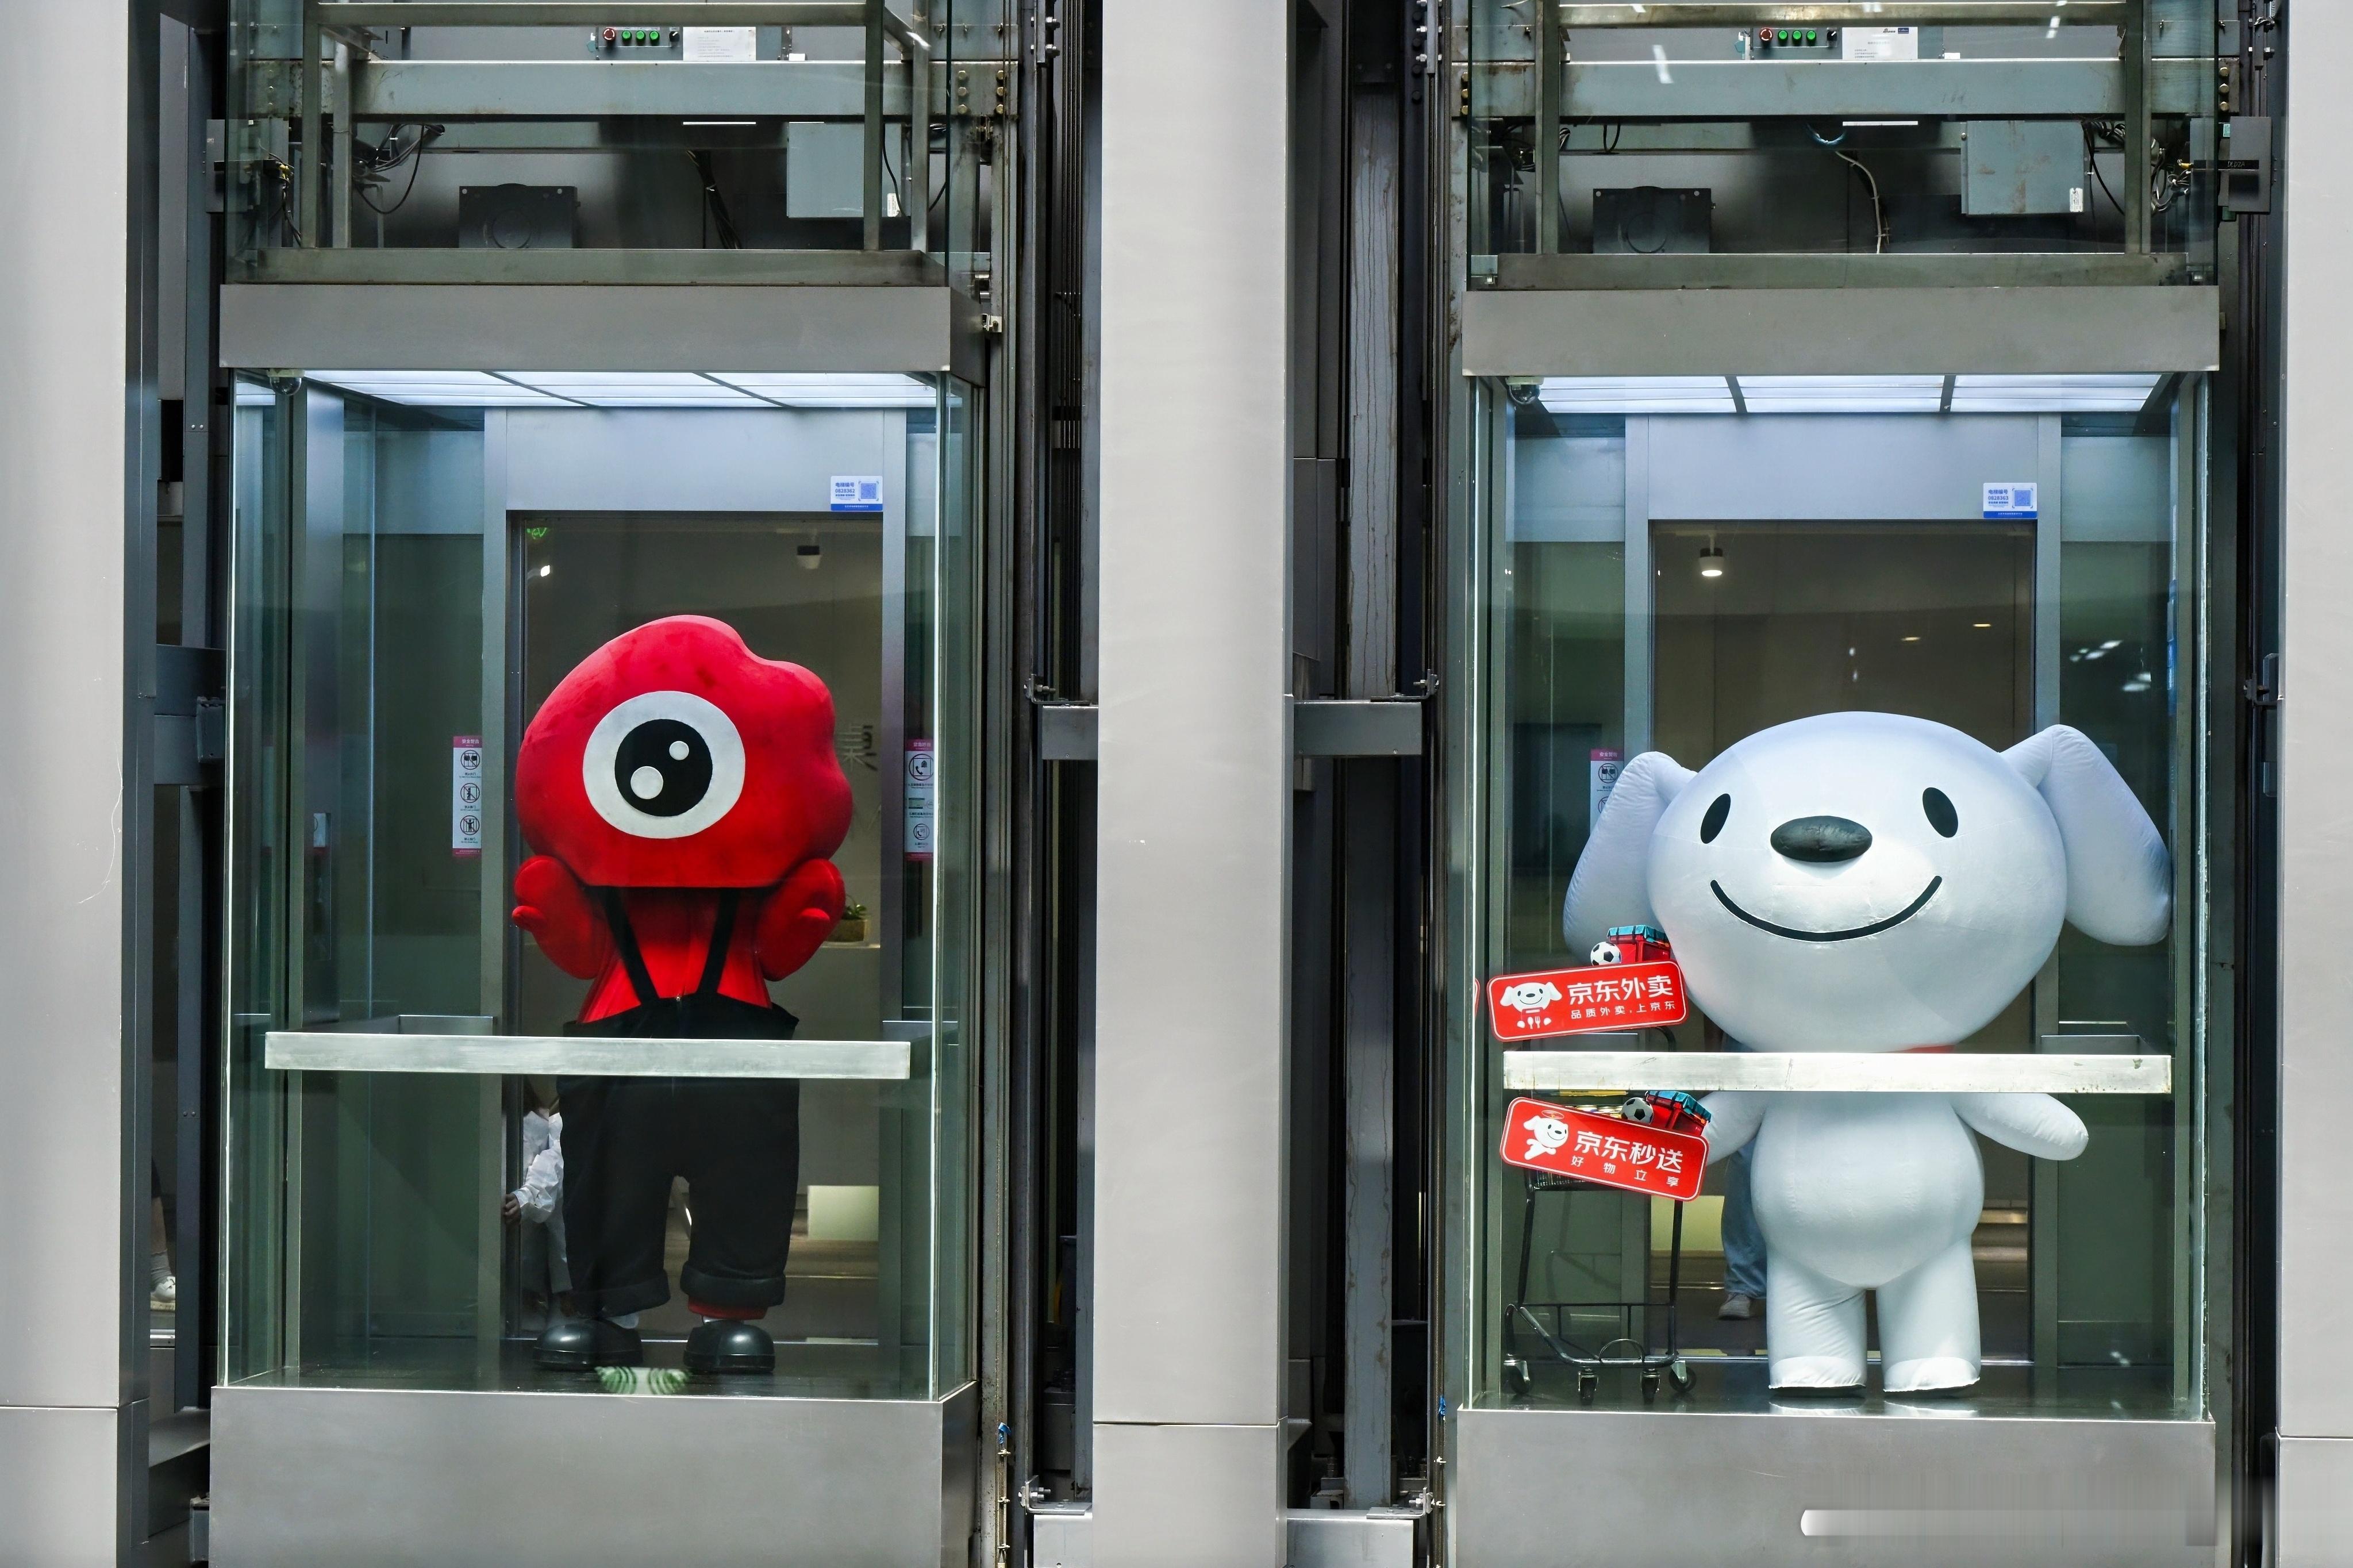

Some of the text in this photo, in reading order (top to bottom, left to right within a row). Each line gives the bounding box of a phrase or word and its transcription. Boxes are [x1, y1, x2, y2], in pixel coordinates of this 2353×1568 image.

[1567, 975, 1674, 1005] 京东外卖
[1574, 1131, 1683, 1174] 京东秒送
[1571, 1155, 1679, 1187] 好物立享
